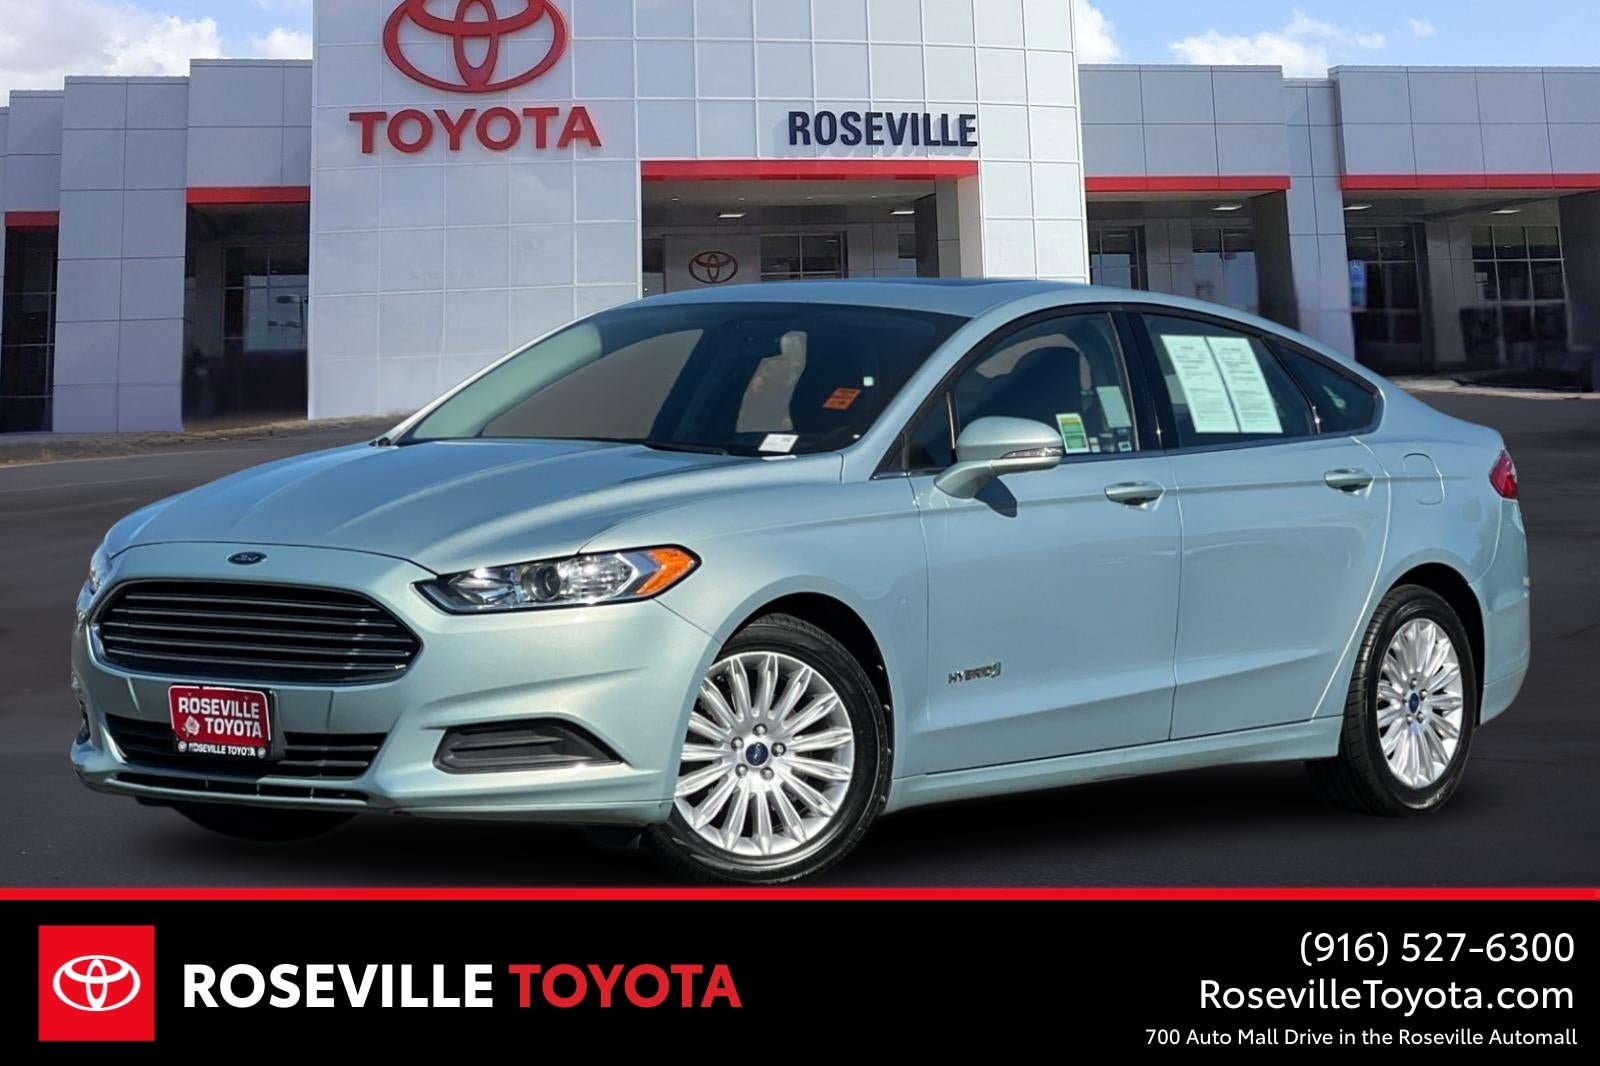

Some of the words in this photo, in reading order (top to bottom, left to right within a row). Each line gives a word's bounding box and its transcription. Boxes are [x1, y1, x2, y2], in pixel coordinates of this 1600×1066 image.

[349, 107, 602, 154] TOYOTA
[788, 110, 978, 148] ROSEVILLE
[178, 697, 260, 719] ROSEVILLE
[204, 717, 262, 738] TOYOTA
[227, 745, 256, 757] TOYOTA
